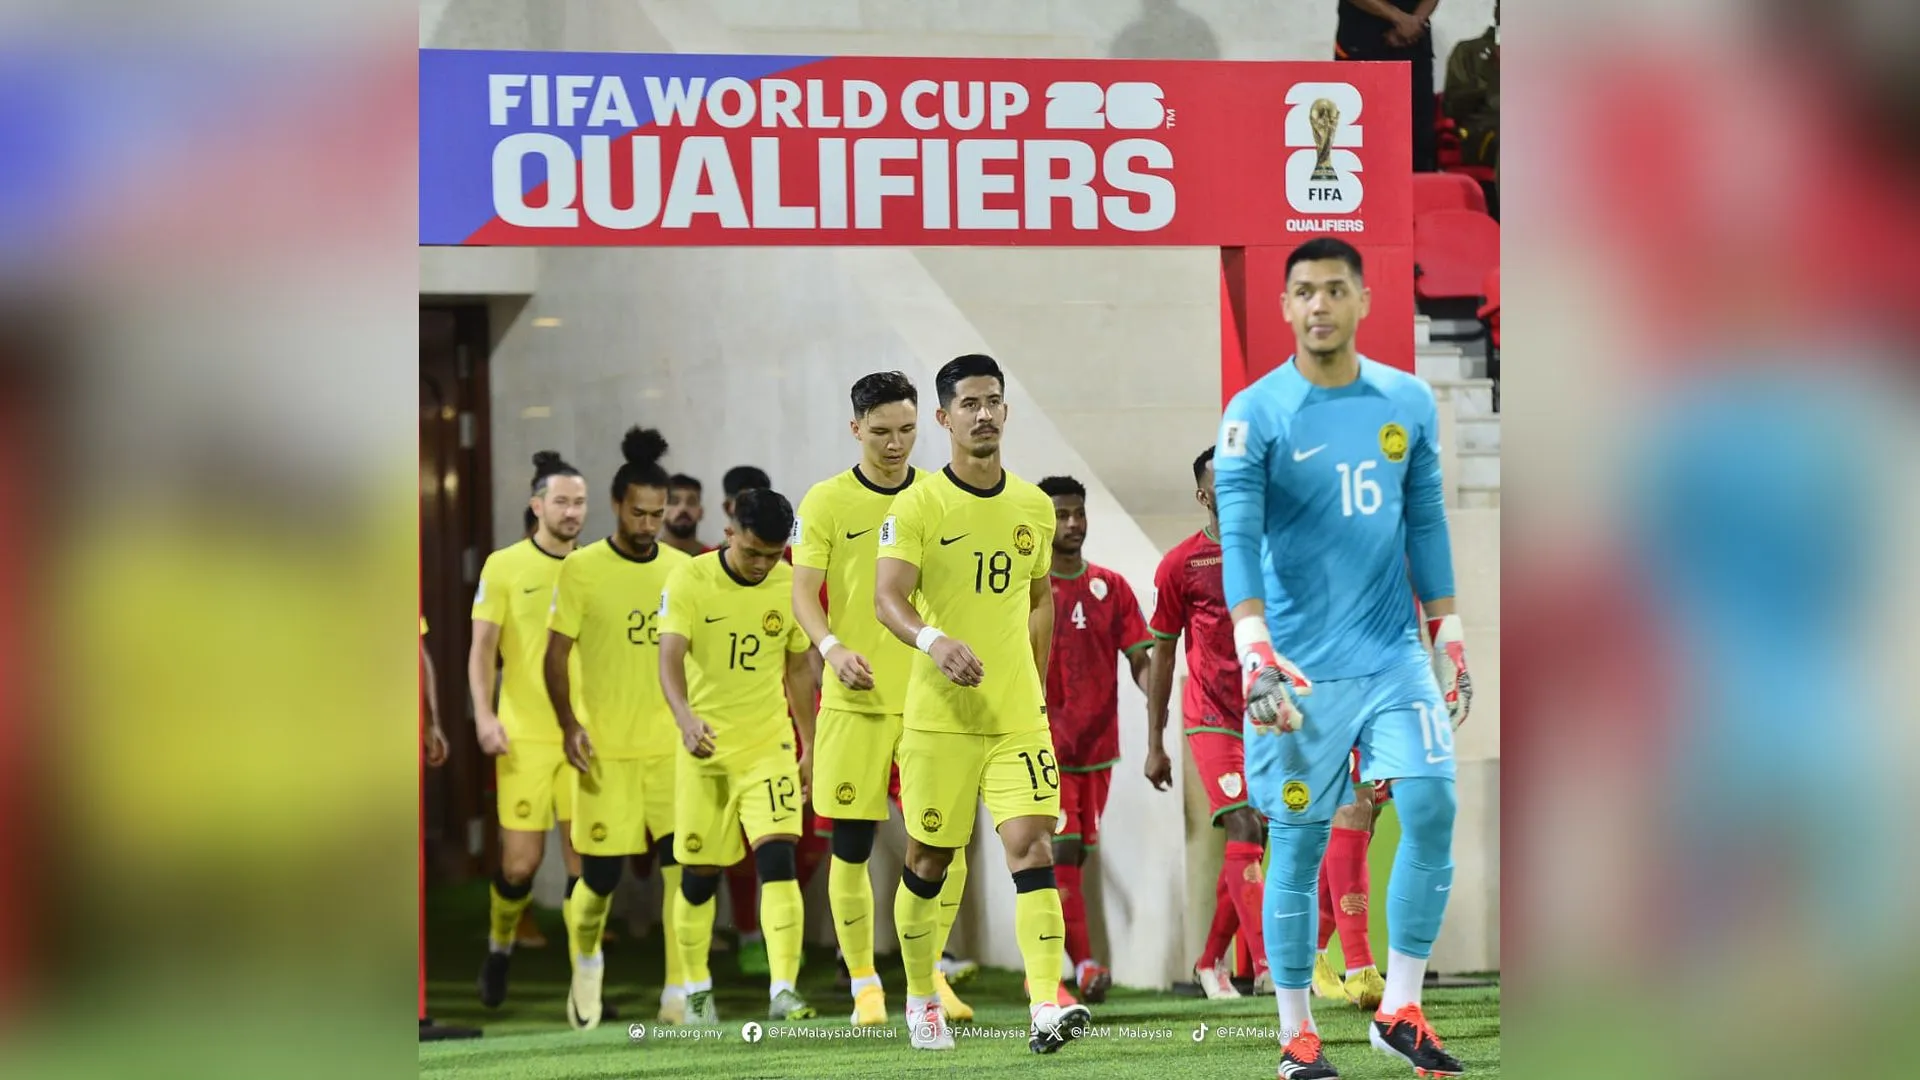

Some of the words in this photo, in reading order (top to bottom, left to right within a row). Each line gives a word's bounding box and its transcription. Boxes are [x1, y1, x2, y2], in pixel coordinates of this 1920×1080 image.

[489, 74, 639, 127] FIFA
[644, 76, 888, 129] WORLD
[901, 79, 1030, 131] CUP
[491, 132, 1176, 232] QUALIFIERS
[1308, 187, 1343, 201] FIFA
[1286, 219, 1364, 232] QUALIFIERS
[1336, 460, 1382, 517] 16
[974, 551, 1012, 594] 18
[1071, 601, 1087, 629] 4
[729, 632, 760, 671] 12
[1018, 749, 1058, 790] 18
[763, 776, 796, 812] 12
